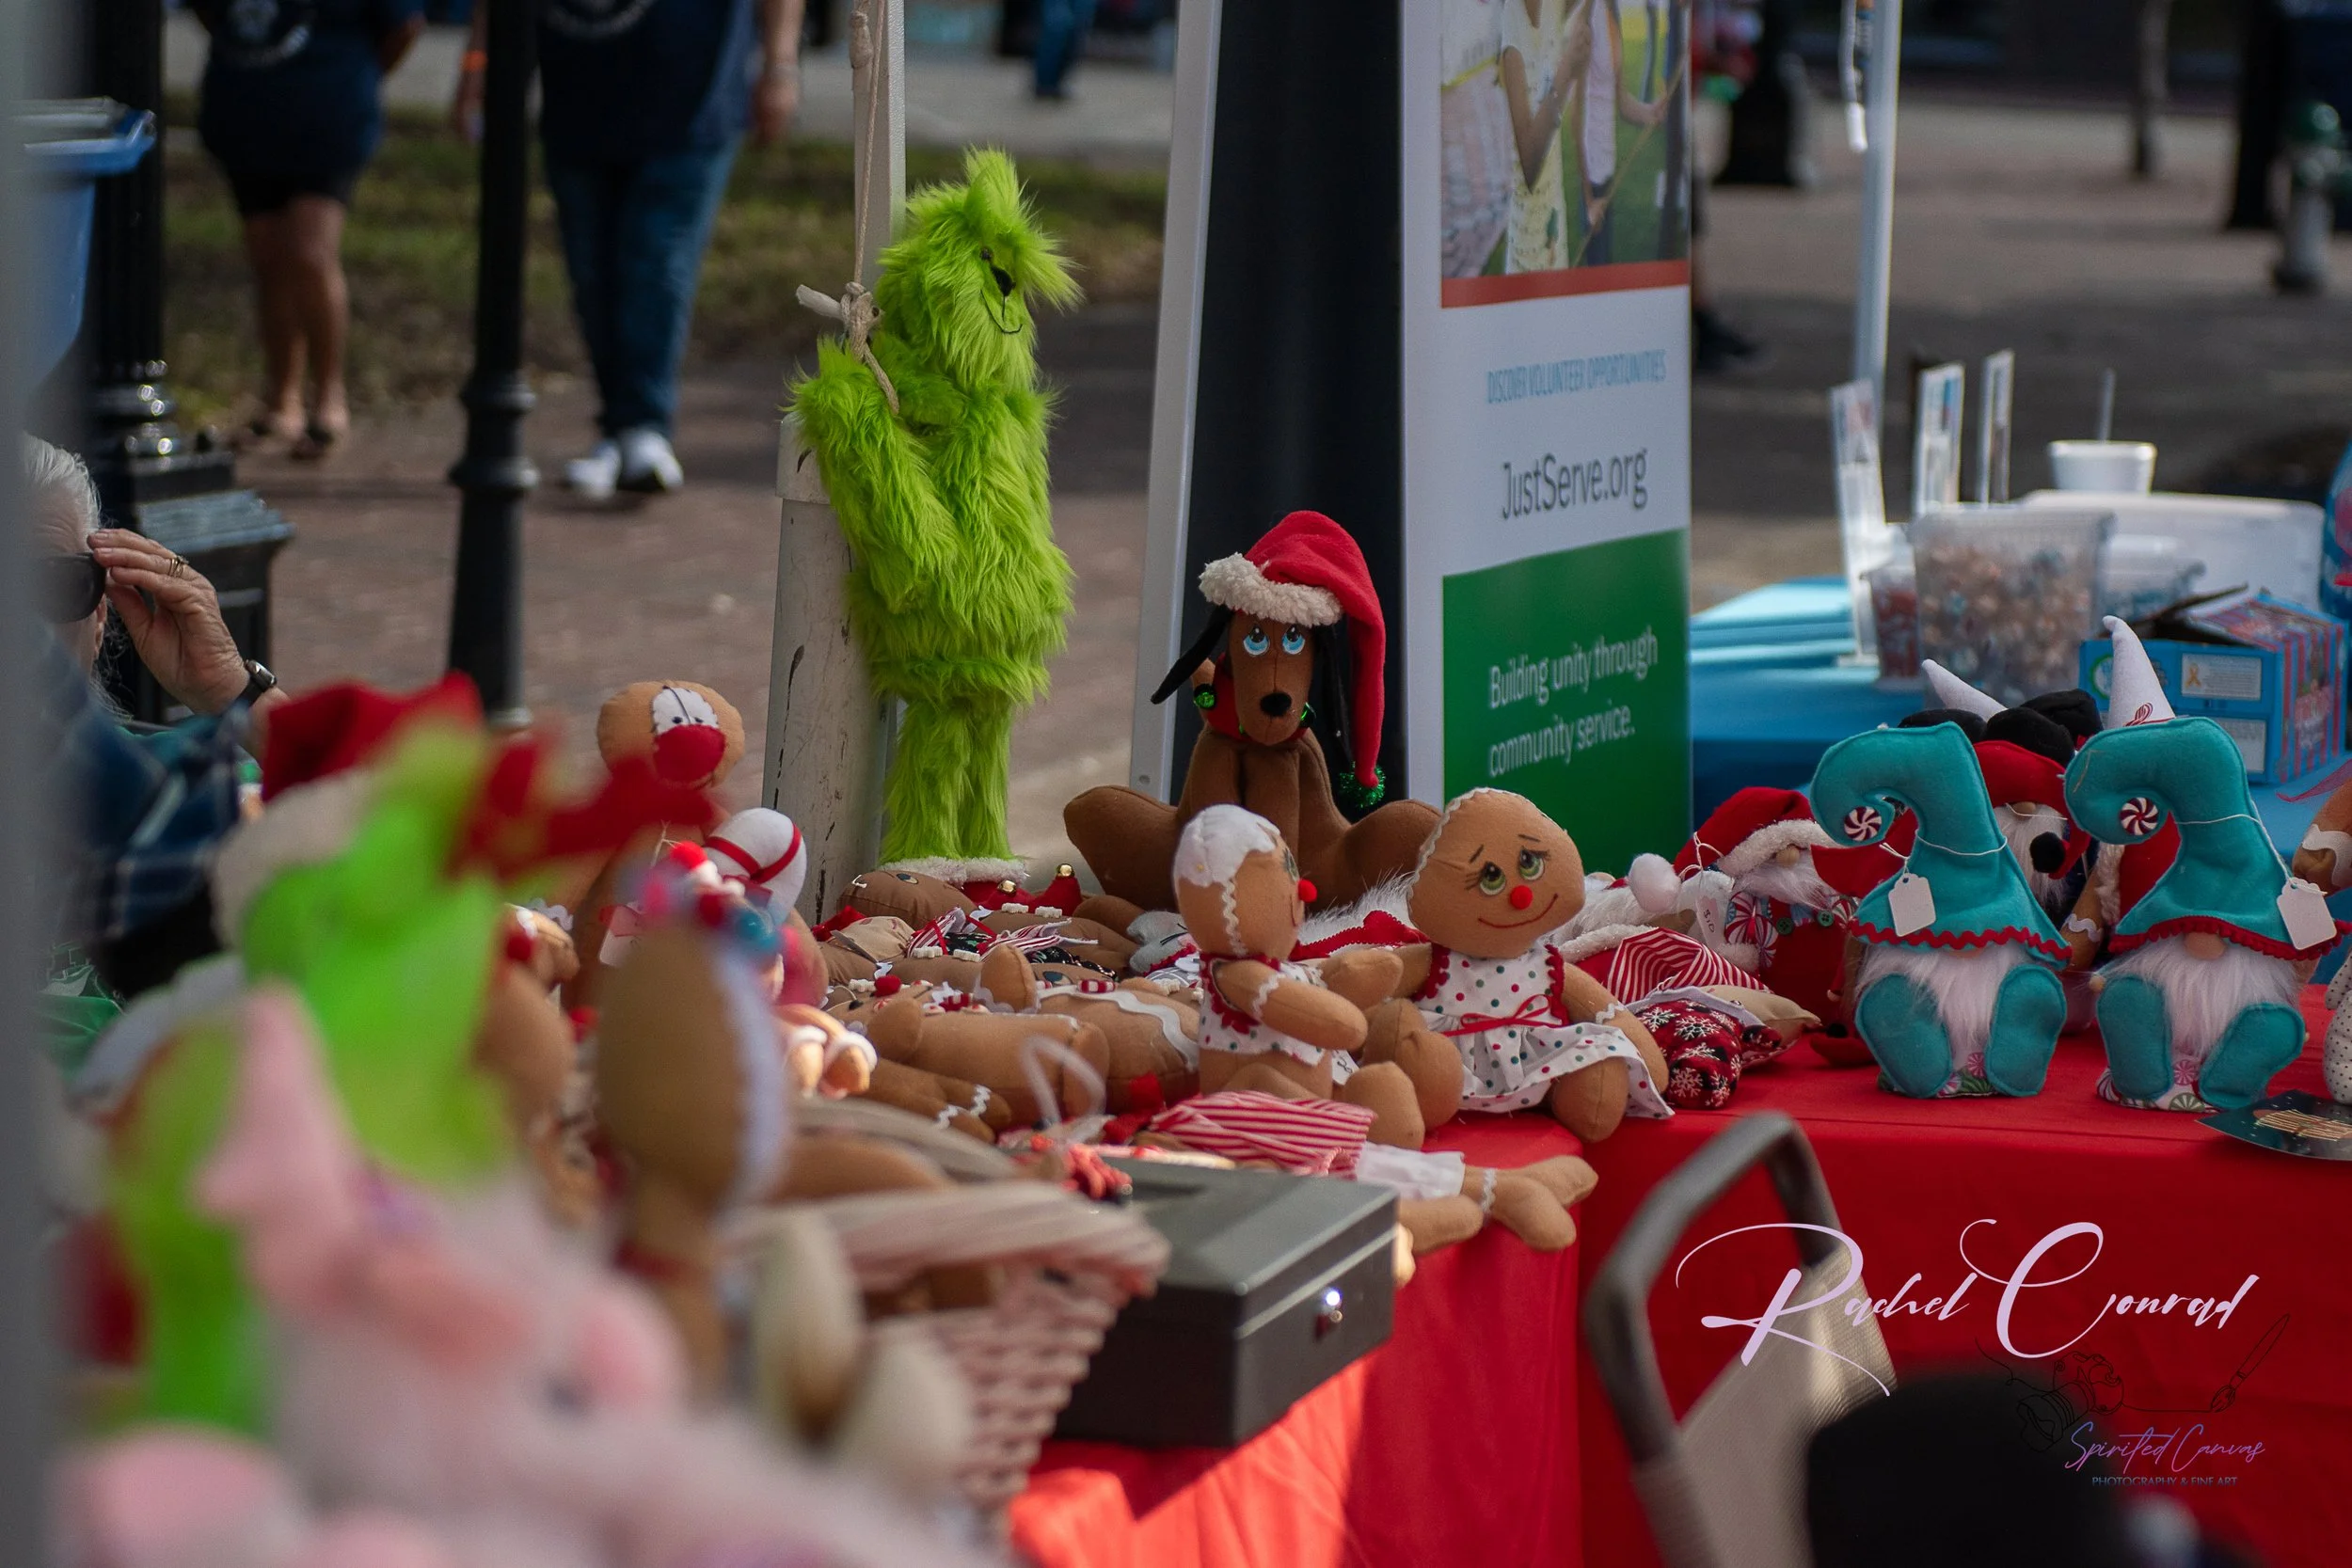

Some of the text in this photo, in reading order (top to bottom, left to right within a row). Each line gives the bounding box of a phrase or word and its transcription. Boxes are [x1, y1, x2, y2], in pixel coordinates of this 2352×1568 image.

[1486, 349, 1666, 404] DISCOVER VOLUNTEER OPPORTUNITIES
[1502, 448, 1648, 519] JustServe.org
[1489, 625, 1659, 709] Building unity through
[1489, 698, 1635, 778] community service.
